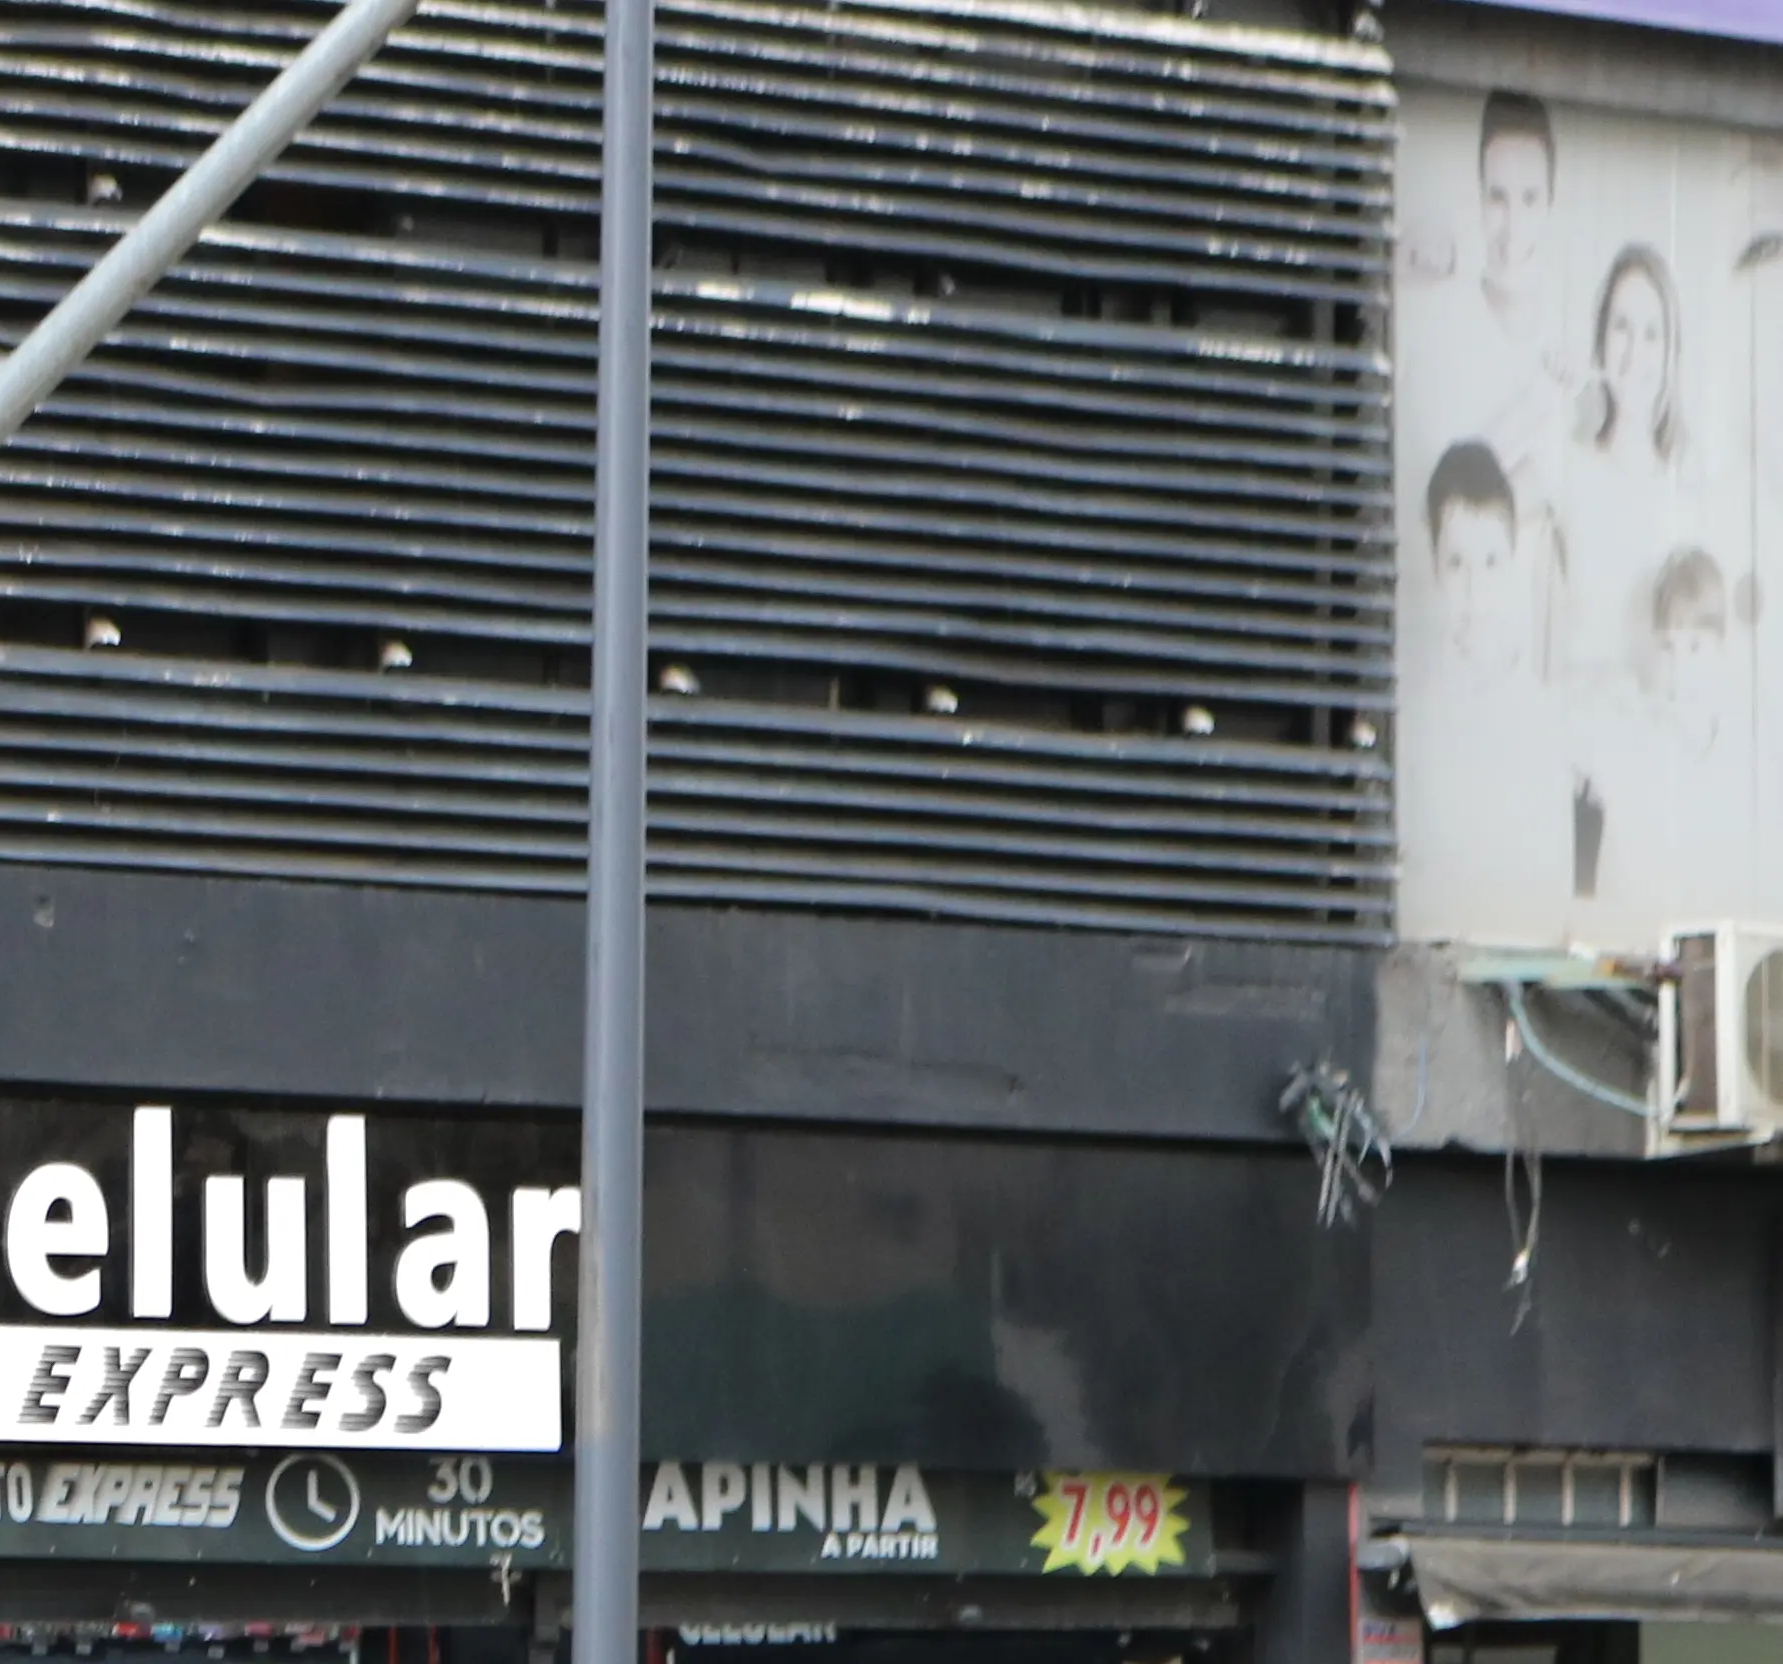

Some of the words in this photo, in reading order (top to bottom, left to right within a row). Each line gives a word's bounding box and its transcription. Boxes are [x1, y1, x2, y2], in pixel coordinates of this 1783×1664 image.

[19, 1345, 453, 1434] EXPRESS
[36, 1462, 243, 1528] EXPRESS
[427, 1455, 493, 1505] 30
[642, 1461, 937, 1532] APINHA
[375, 1509, 544, 1548] MINUTOS
[821, 1532, 843, 1558] A
[845, 1535, 938, 1559] PARTIR
[1062, 1482, 1159, 1556] 7,99
